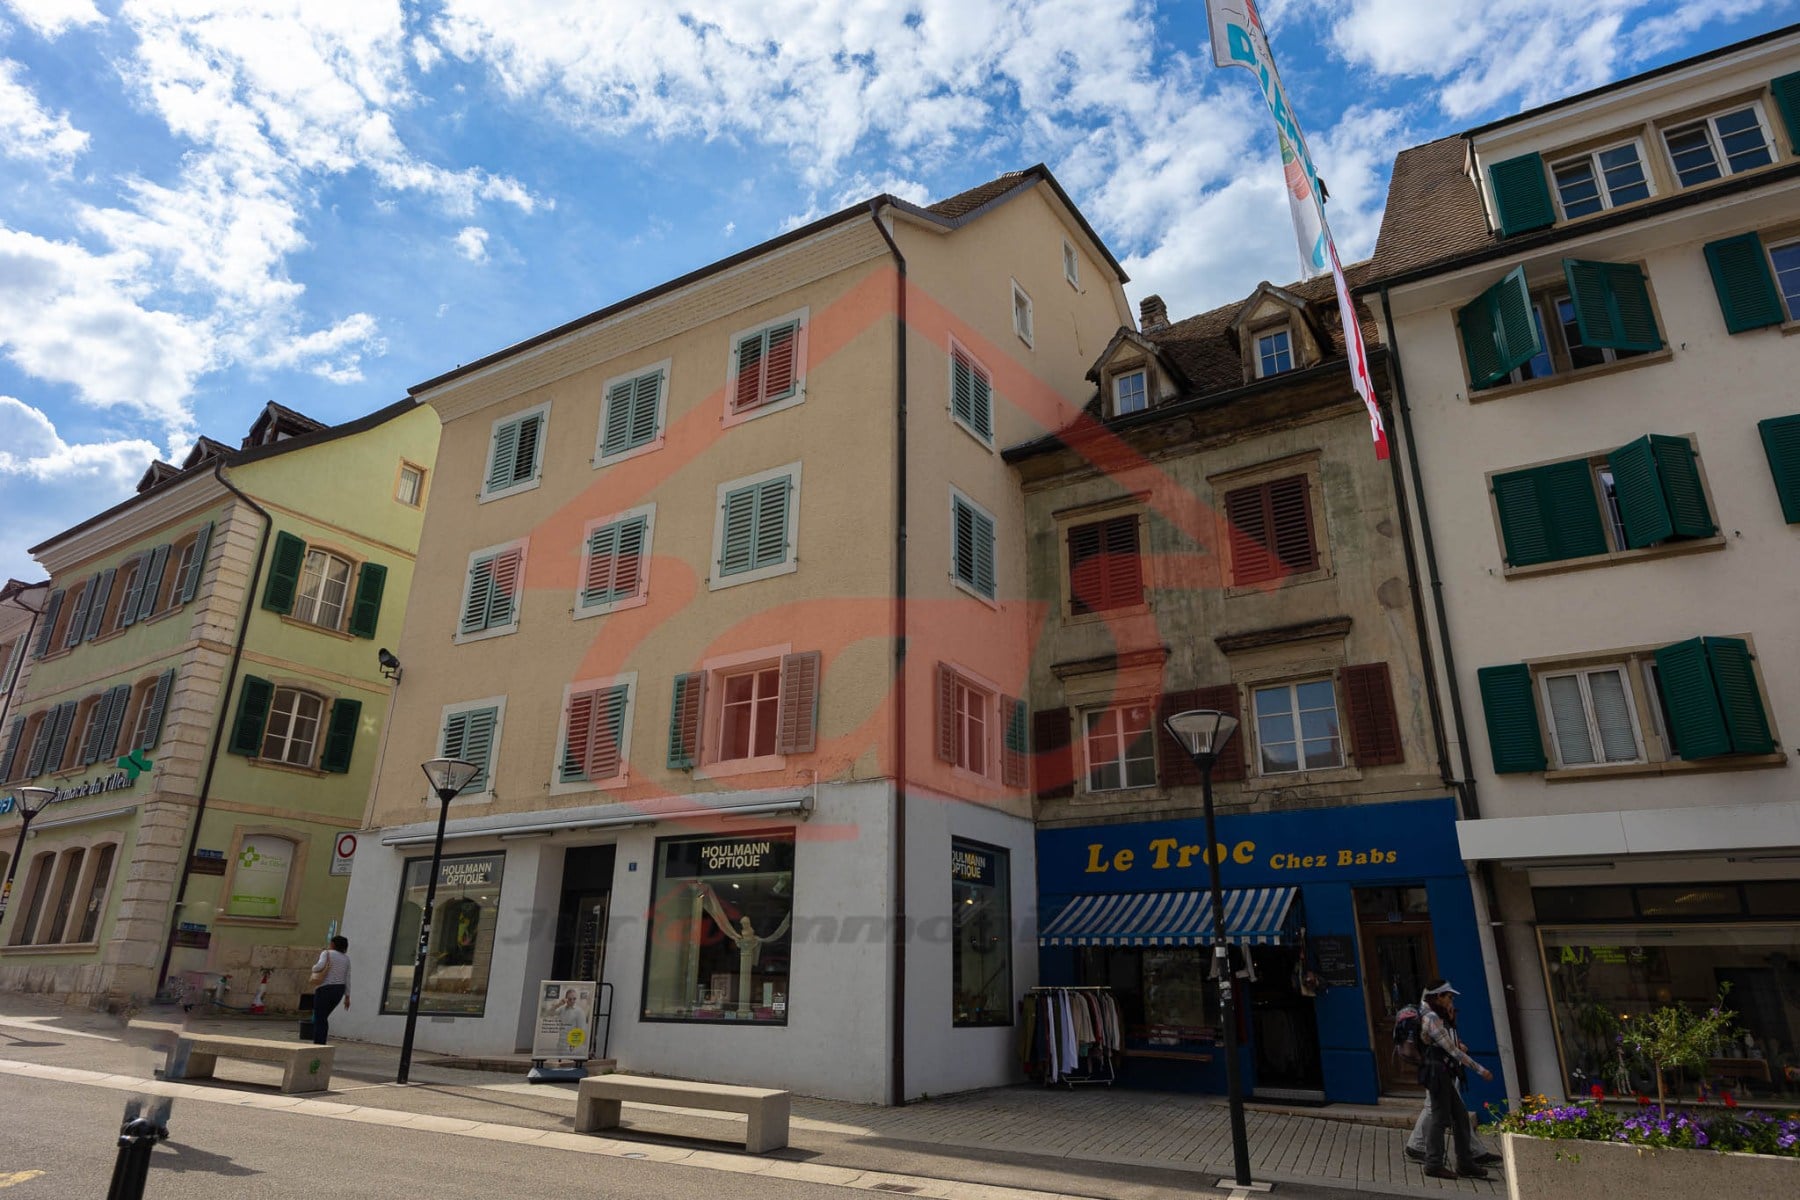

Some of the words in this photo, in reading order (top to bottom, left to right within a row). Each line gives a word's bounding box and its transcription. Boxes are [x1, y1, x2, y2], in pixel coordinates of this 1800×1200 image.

[89, 776, 101, 794] du
[701, 842, 770, 858] HOULMANN
[1084, 843, 1135, 873] Le
[1149, 837, 1256, 870] Troc
[1269, 852, 1328, 870] Chez
[1337, 848, 1397, 866] Babs
[709, 855, 761, 869] OPTIQUE
[952, 850, 986, 868] OULMANN
[441, 862, 492, 876] HOULMANN
[446, 873, 485, 886] OPTIQUE
